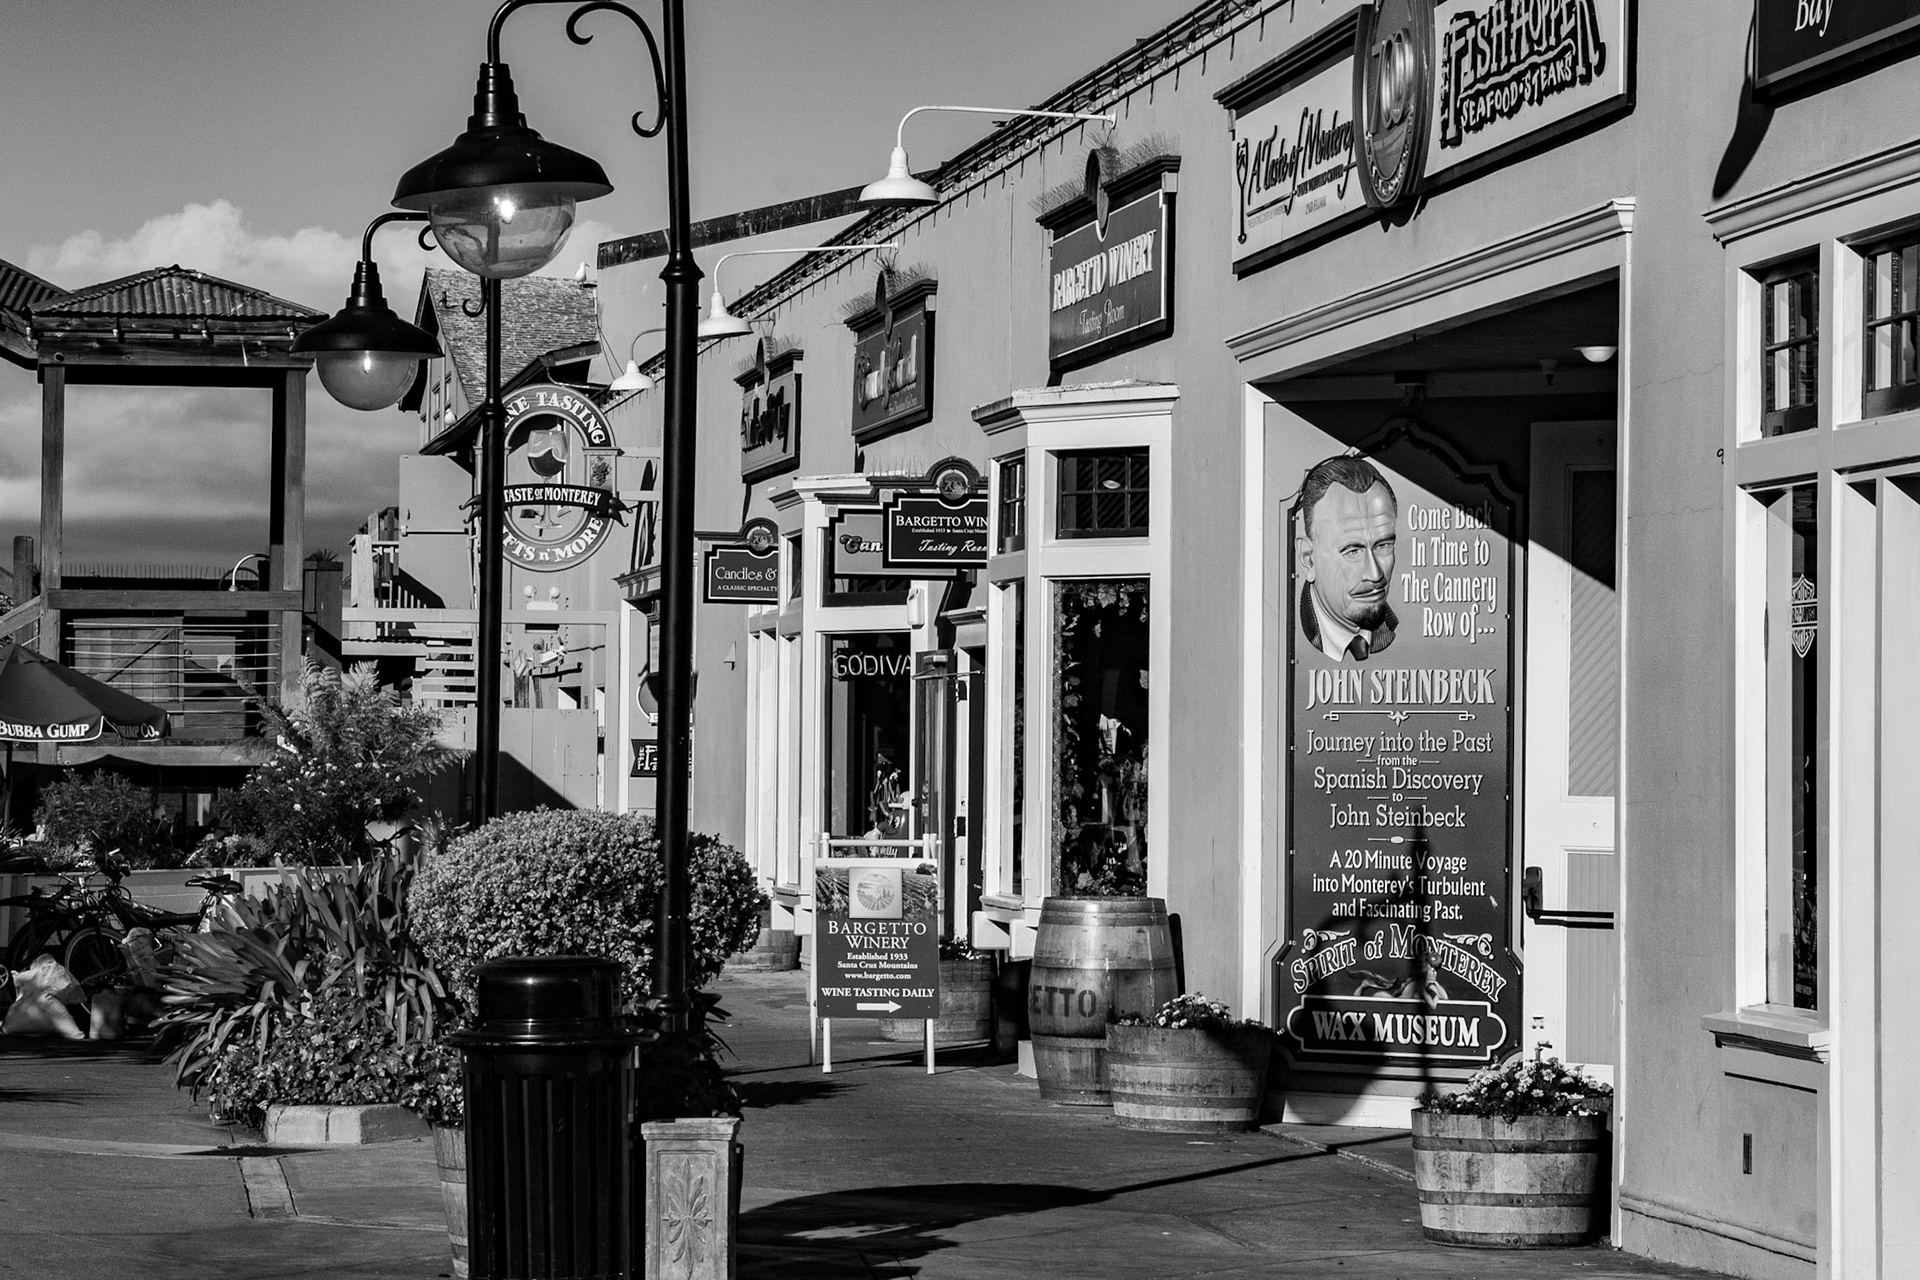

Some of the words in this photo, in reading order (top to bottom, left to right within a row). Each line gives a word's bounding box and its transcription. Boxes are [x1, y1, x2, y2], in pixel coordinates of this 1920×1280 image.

[1521, 51, 1573, 102] STEAKS
[1262, 124, 1290, 190] Taste
[1284, 106, 1309, 216] of
[1302, 108, 1354, 200] Monterey
[1052, 252, 1107, 312] BARGETTO
[1108, 229, 1157, 287] WINERY
[535, 391, 606, 445] TASTING
[504, 487, 534, 503] TASTE
[544, 487, 602, 507] MONTEREY
[896, 515, 961, 527] BARGETTO
[1408, 504, 1451, 531] Come
[1455, 501, 1492, 529] Back
[552, 517, 604, 562] MORE
[918, 540, 958, 556] Tasting
[1411, 537, 1427, 567] In
[1431, 532, 1468, 567] Time
[1474, 535, 1490, 566] to
[715, 566, 763, 581] Candles
[765, 567, 778, 581] &
[1402, 570, 1430, 603] The
[1434, 572, 1498, 613] Cannery
[1423, 607, 1457, 637] Row
[833, 655, 910, 676] GODIVA
[1306, 669, 1364, 711] JOHN
[1371, 669, 1497, 705] STEINBECK
[0, 721, 44, 739] BUBBA
[46, 723, 90, 738] GUMP
[1307, 729, 1375, 757] Journey
[1380, 731, 1414, 752] into
[1419, 729, 1447, 752] the
[1452, 730, 1493, 752] Past
[1377, 755, 1400, 766] from
[1402, 755, 1418, 766] the
[1314, 766, 1387, 794] Spanish
[1392, 767, 1483, 795] Discovery
[1392, 793, 1404, 802] to
[1330, 804, 1370, 828] John
[1376, 804, 1466, 828] Steinbeck
[1329, 850, 1342, 868] A
[1344, 850, 1362, 869] 20
[1365, 851, 1413, 869] Minute
[1416, 851, 1467, 875] Voyage
[1313, 873, 1338, 893] into
[1342, 874, 1414, 897] Monterey's
[1420, 876, 1486, 896] Turbulent
[1332, 899, 1356, 917] and
[1359, 899, 1431, 922] Fascinating
[1434, 901, 1463, 920] Past.
[828, 921, 926, 935] BARGETTO
[845, 935, 910, 949] WINERY
[837, 961, 858, 969] Santa
[859, 961, 877, 969] Cruz
[879, 961, 918, 969] Mountains
[1291, 937, 1357, 993] SPIRIT
[1364, 930, 1384, 960] of
[1389, 923, 1507, 1003] MONTEREY
[844, 972, 912, 981] www.bargetto.com
[821, 987, 852, 997] WINE
[853, 988, 900, 998] TASTING
[902, 988, 935, 998] DAILY
[1312, 1010, 1367, 1041] WAX
[1373, 1013, 1480, 1047] MUSEUM
